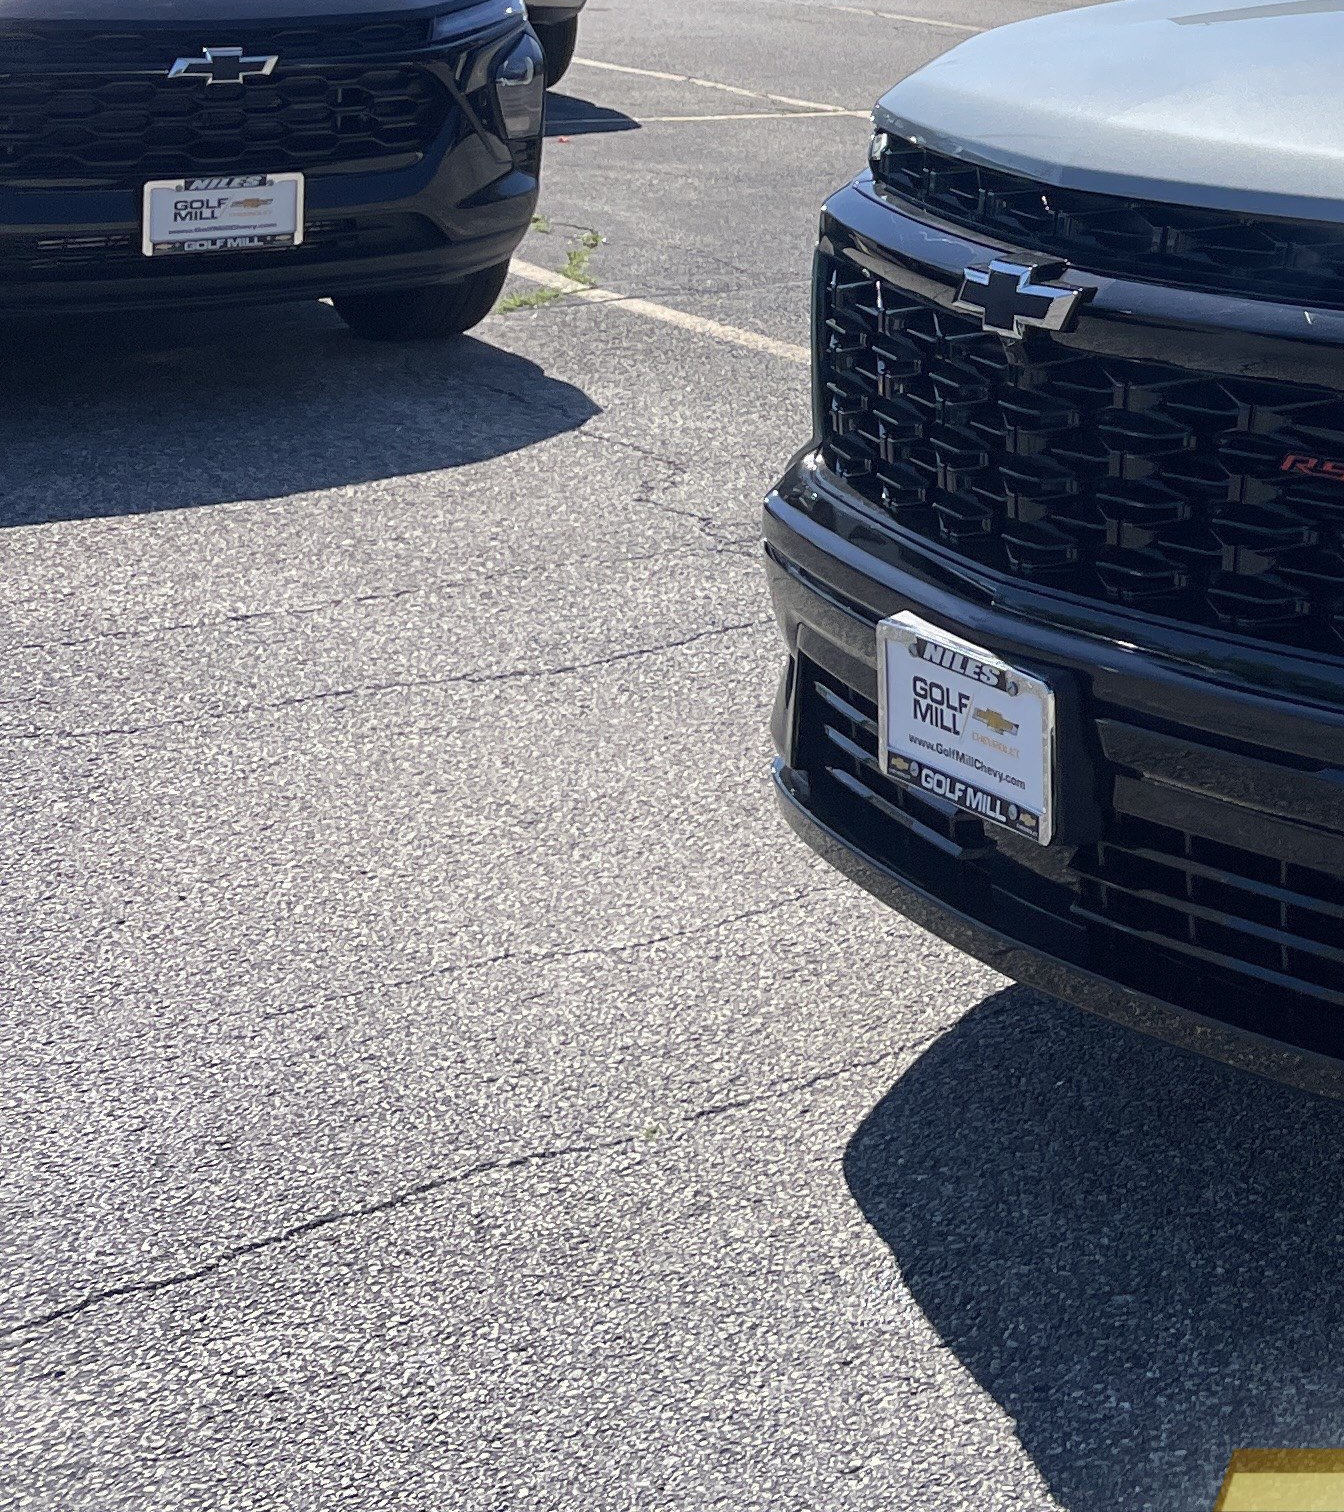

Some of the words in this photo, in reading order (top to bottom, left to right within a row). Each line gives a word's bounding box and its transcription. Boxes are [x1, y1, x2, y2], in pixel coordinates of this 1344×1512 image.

[189, 175, 263, 190] NILES
[173, 197, 229, 211] GOLF
[173, 209, 219, 223] MILL
[184, 238, 226, 251] GOLF
[226, 236, 264, 247] MILL
[921, 642, 1001, 687] NILES
[912, 675, 971, 715] GOLF
[912, 697, 960, 736] MILL
[908, 733, 1026, 790] www.GolfMillChevy.com
[921, 768, 966, 802] GOLF
[965, 787, 1007, 823] MILL
